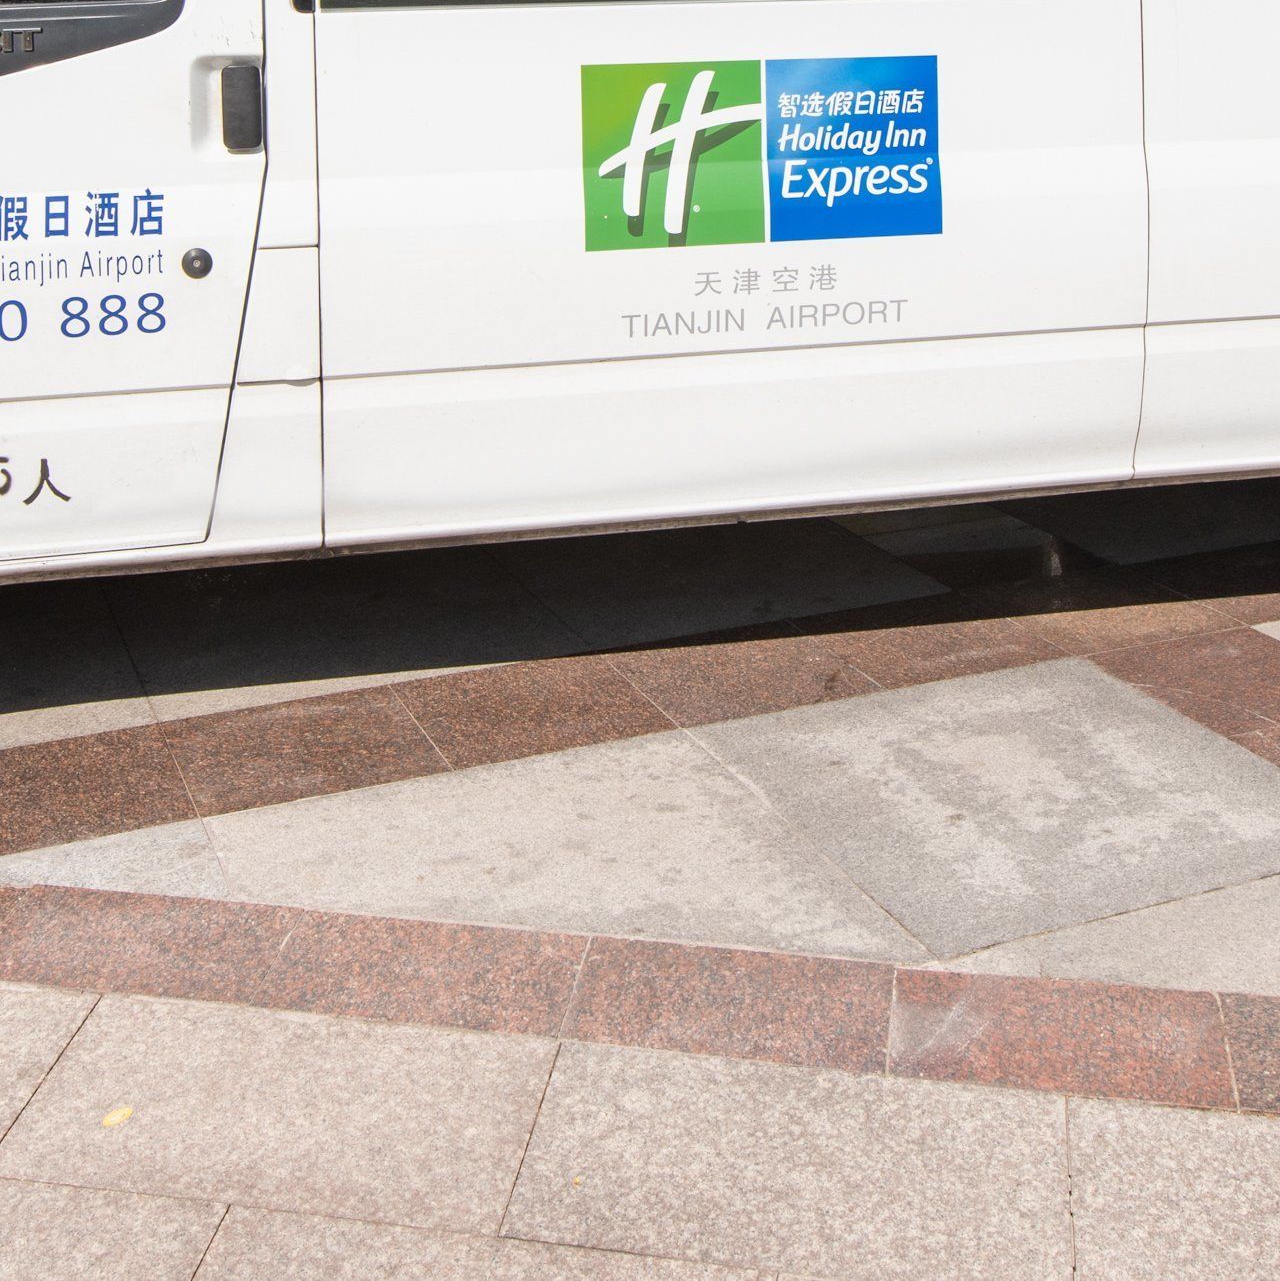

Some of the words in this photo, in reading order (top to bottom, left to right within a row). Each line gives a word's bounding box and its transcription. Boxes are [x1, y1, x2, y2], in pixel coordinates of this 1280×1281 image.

[778, 89, 924, 118] 智选假日酒店
[778, 122, 882, 156] Holiday
[885, 120, 927, 148] Inn
[781, 159, 928, 208] Express
[80, 249, 164, 283] Airport
[693, 263, 838, 297] 天津空港
[60, 292, 167, 339] 888
[620, 308, 745, 339] TIANJIN
[766, 299, 909, 330] AIRPORT
